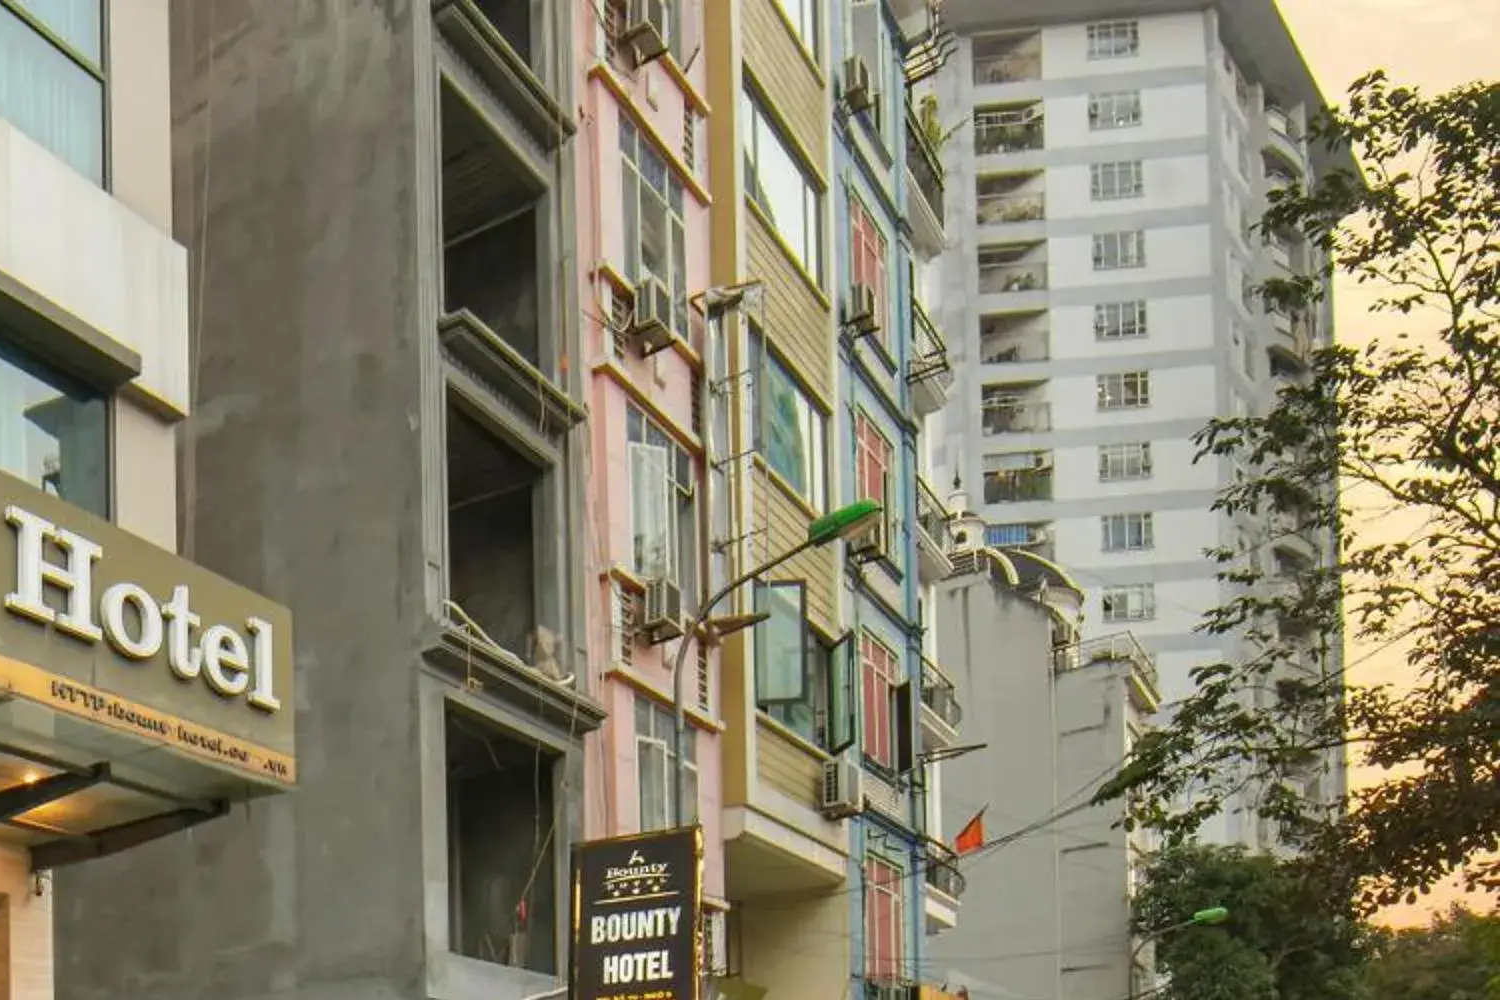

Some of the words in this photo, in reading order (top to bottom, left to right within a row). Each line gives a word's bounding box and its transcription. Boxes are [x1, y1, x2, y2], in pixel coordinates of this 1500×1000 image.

[3, 504, 281, 711] Hotel
[591, 907, 681, 944] BOUNTY
[603, 950, 674, 984] HOTEL
